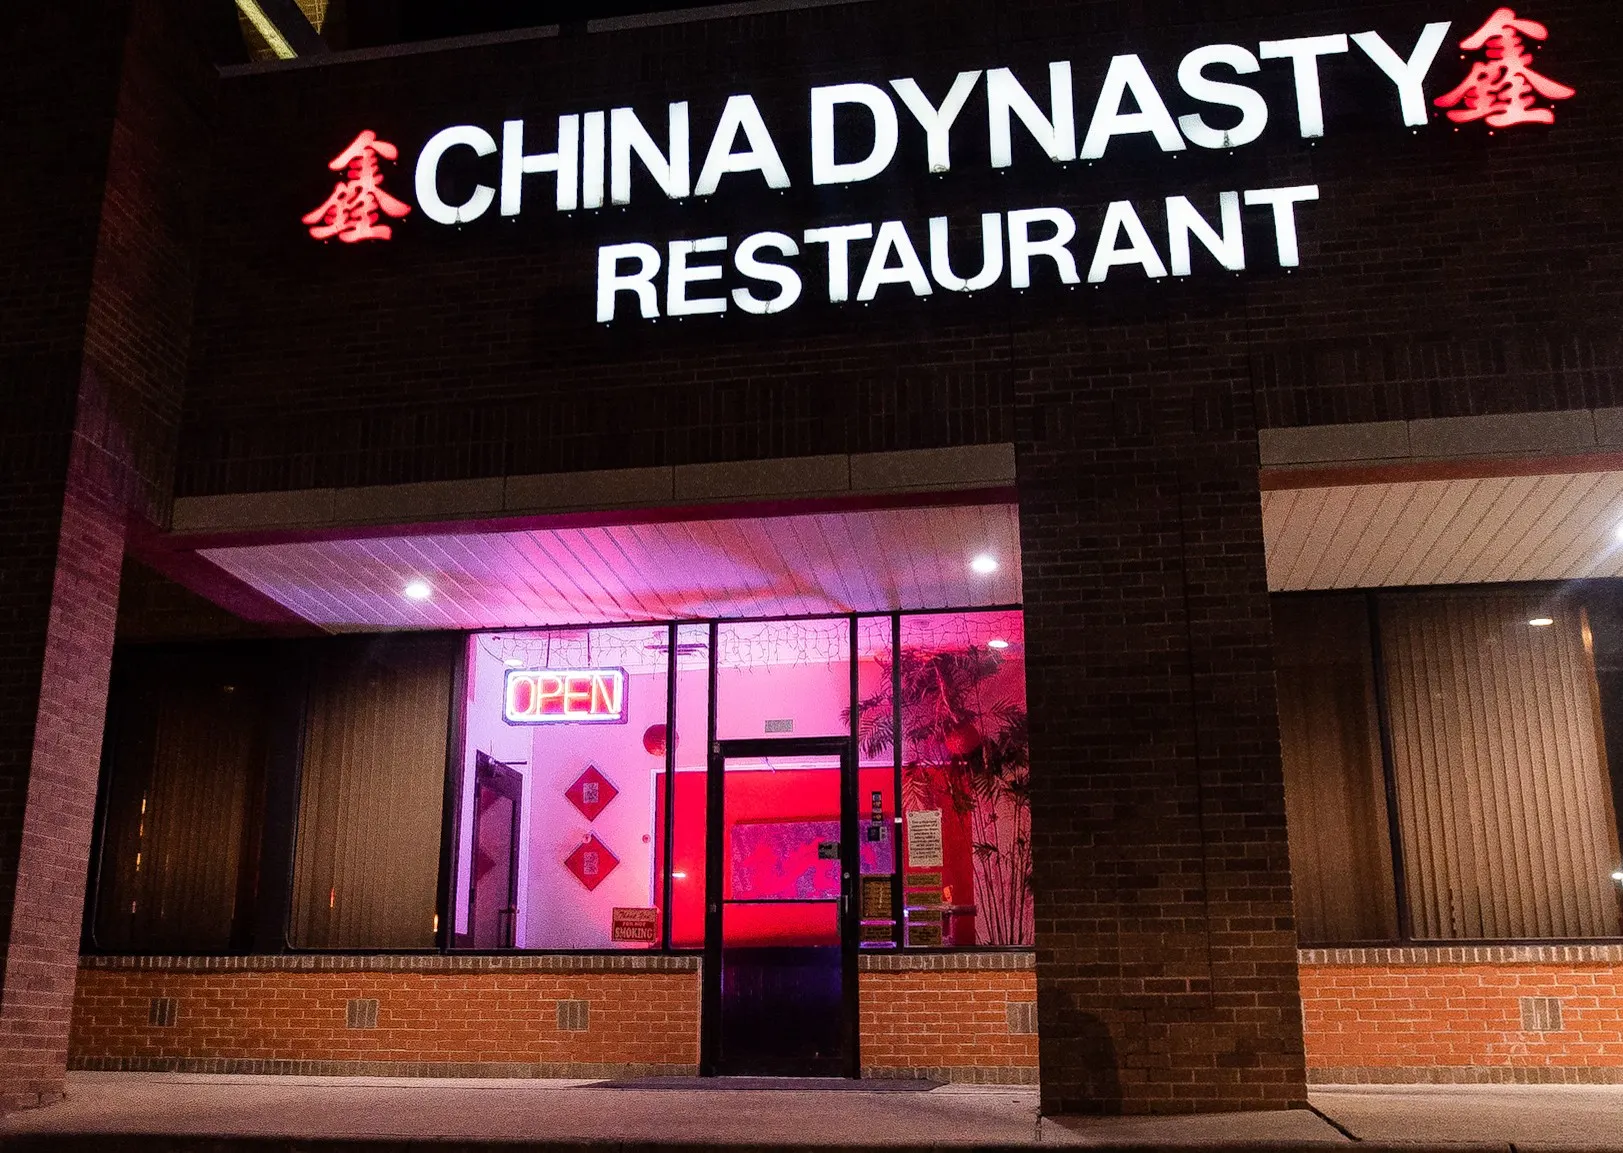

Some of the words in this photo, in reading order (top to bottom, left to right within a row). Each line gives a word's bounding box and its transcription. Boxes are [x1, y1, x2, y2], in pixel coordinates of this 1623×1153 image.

[414, 95, 791, 225] CHINA
[811, 22, 1452, 186] DYNASTY
[1434, 8, 1575, 128] 鑫
[302, 130, 411, 243] 鑫
[597, 185, 1319, 323] RESTAURANT
[511, 675, 620, 716] OPEN
[615, 927, 653, 939] SMOKING
